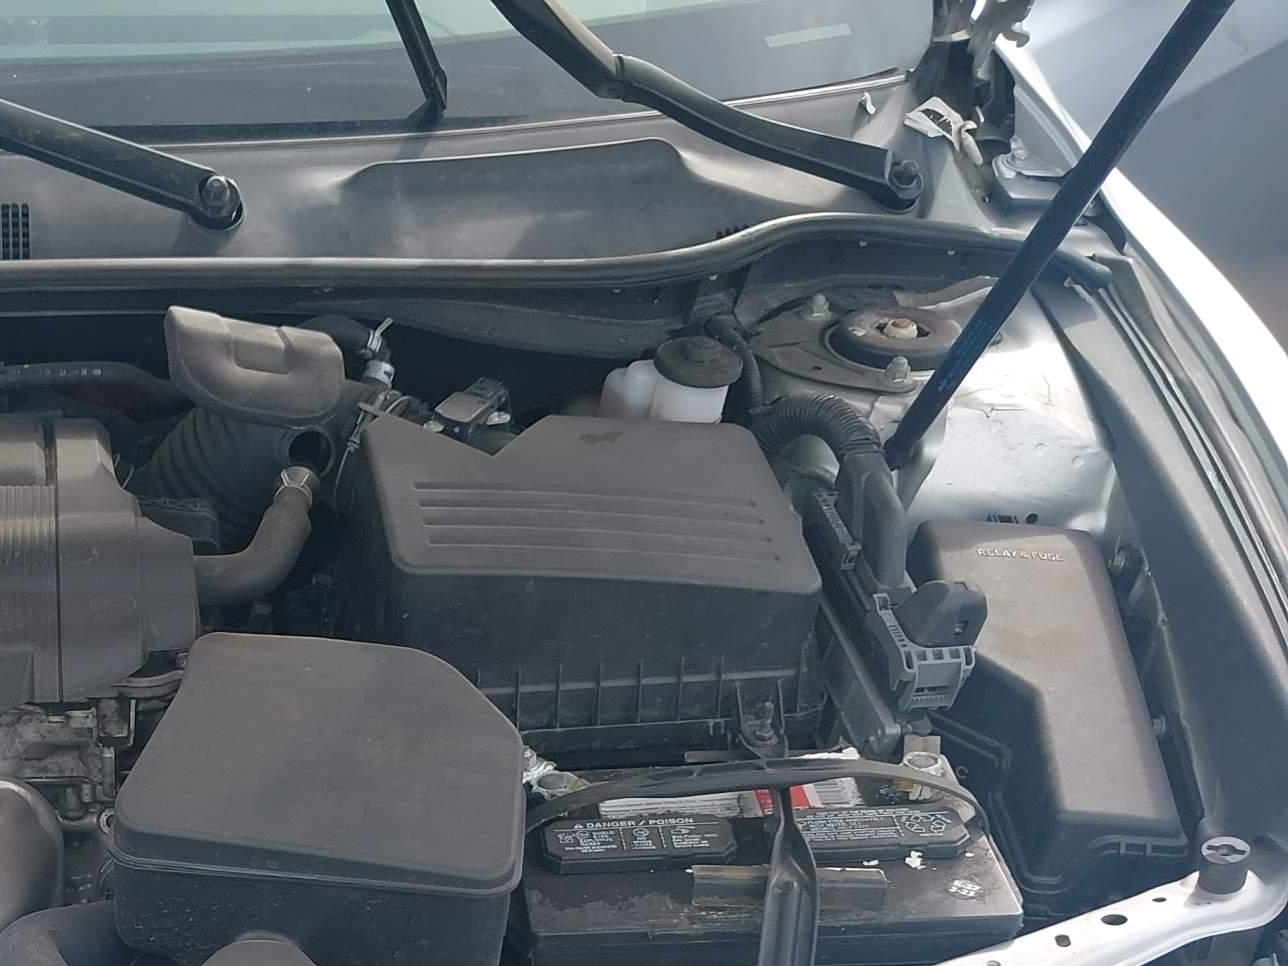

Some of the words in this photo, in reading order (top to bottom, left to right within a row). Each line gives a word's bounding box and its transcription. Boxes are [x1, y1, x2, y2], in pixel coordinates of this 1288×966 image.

[977, 547, 1017, 558] RELAY
[1031, 551, 1065, 562] FUSE
[585, 820, 637, 829] DANGER
[648, 817, 694, 826] POISON
